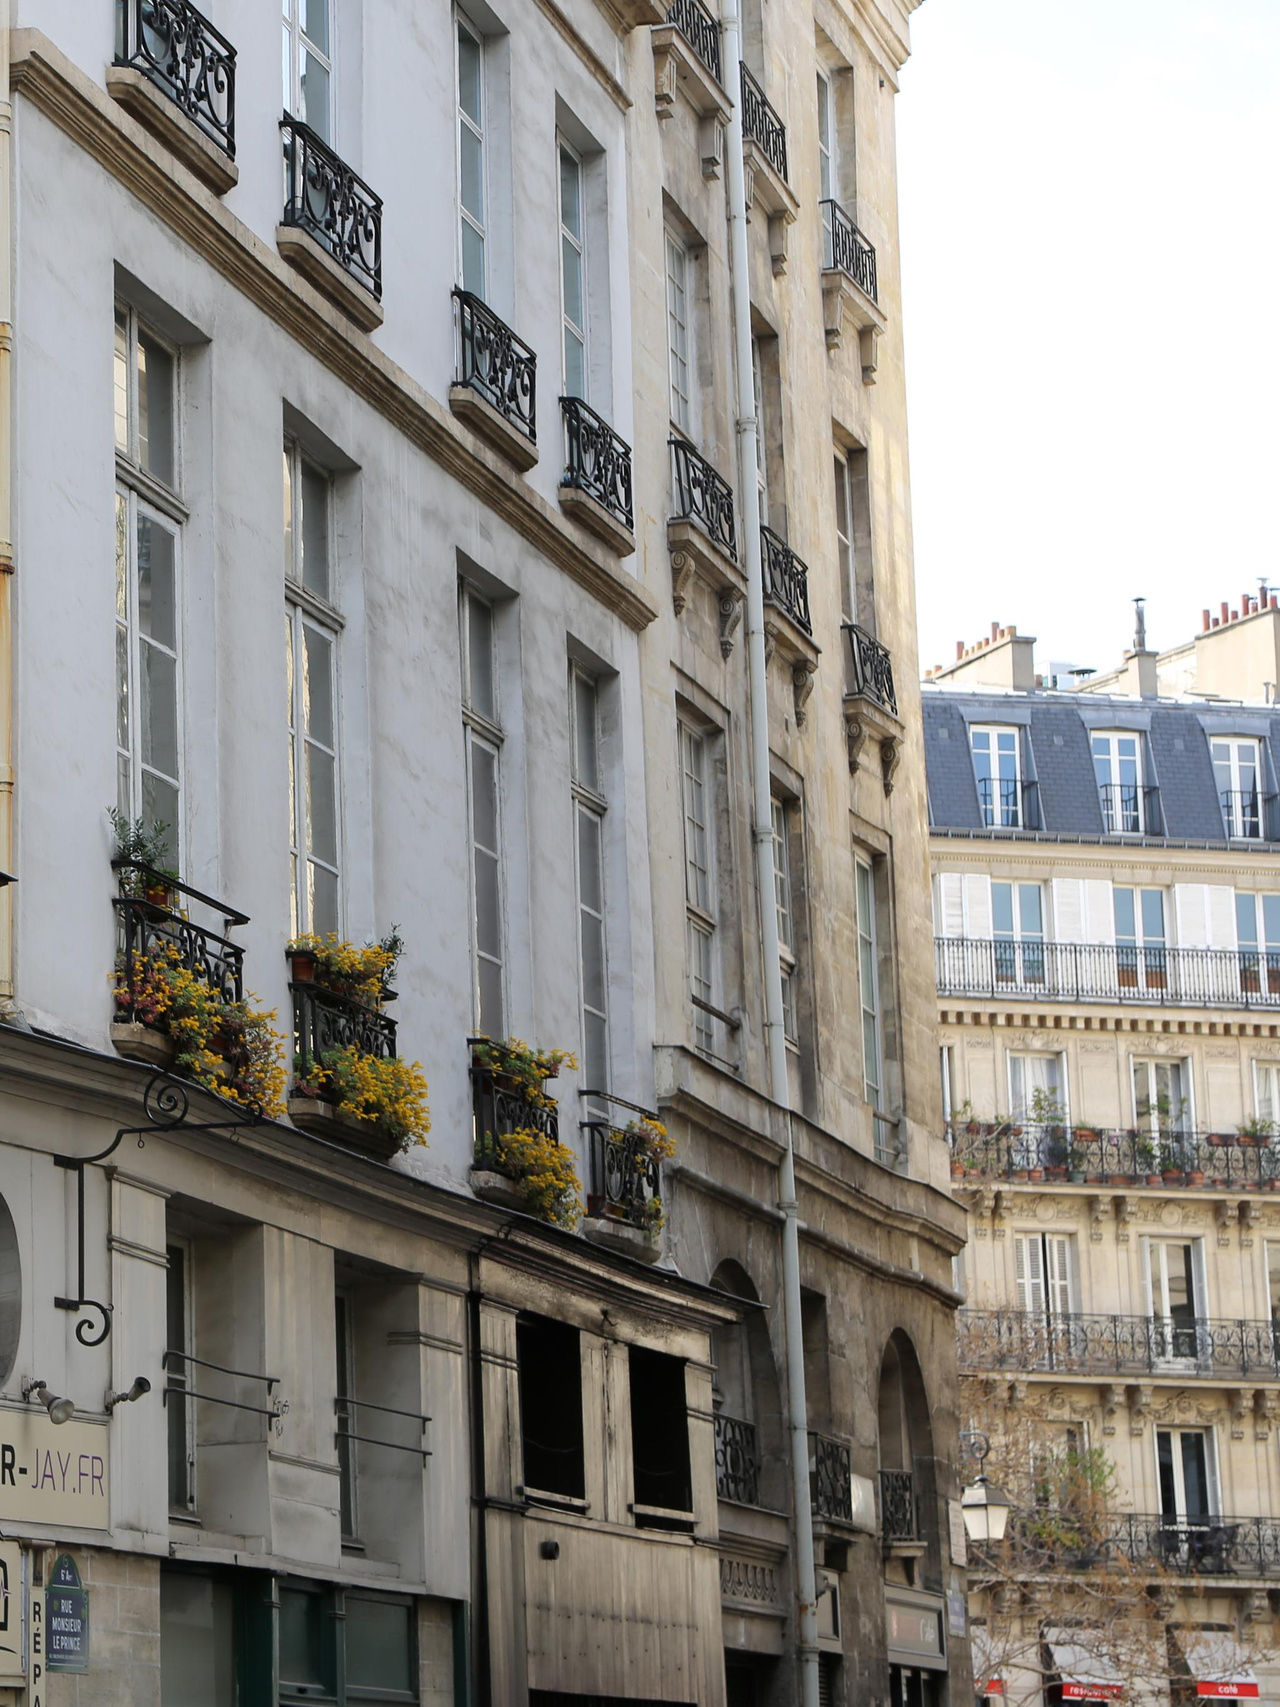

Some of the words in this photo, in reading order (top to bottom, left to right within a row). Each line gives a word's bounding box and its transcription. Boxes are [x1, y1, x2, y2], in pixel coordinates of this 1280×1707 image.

[61, 1599, 72, 1613] RUE
[52, 1617, 81, 1633] MONSIEUR
[53, 1636, 60, 1649] LE
[61, 1636, 80, 1650] PRINCE
